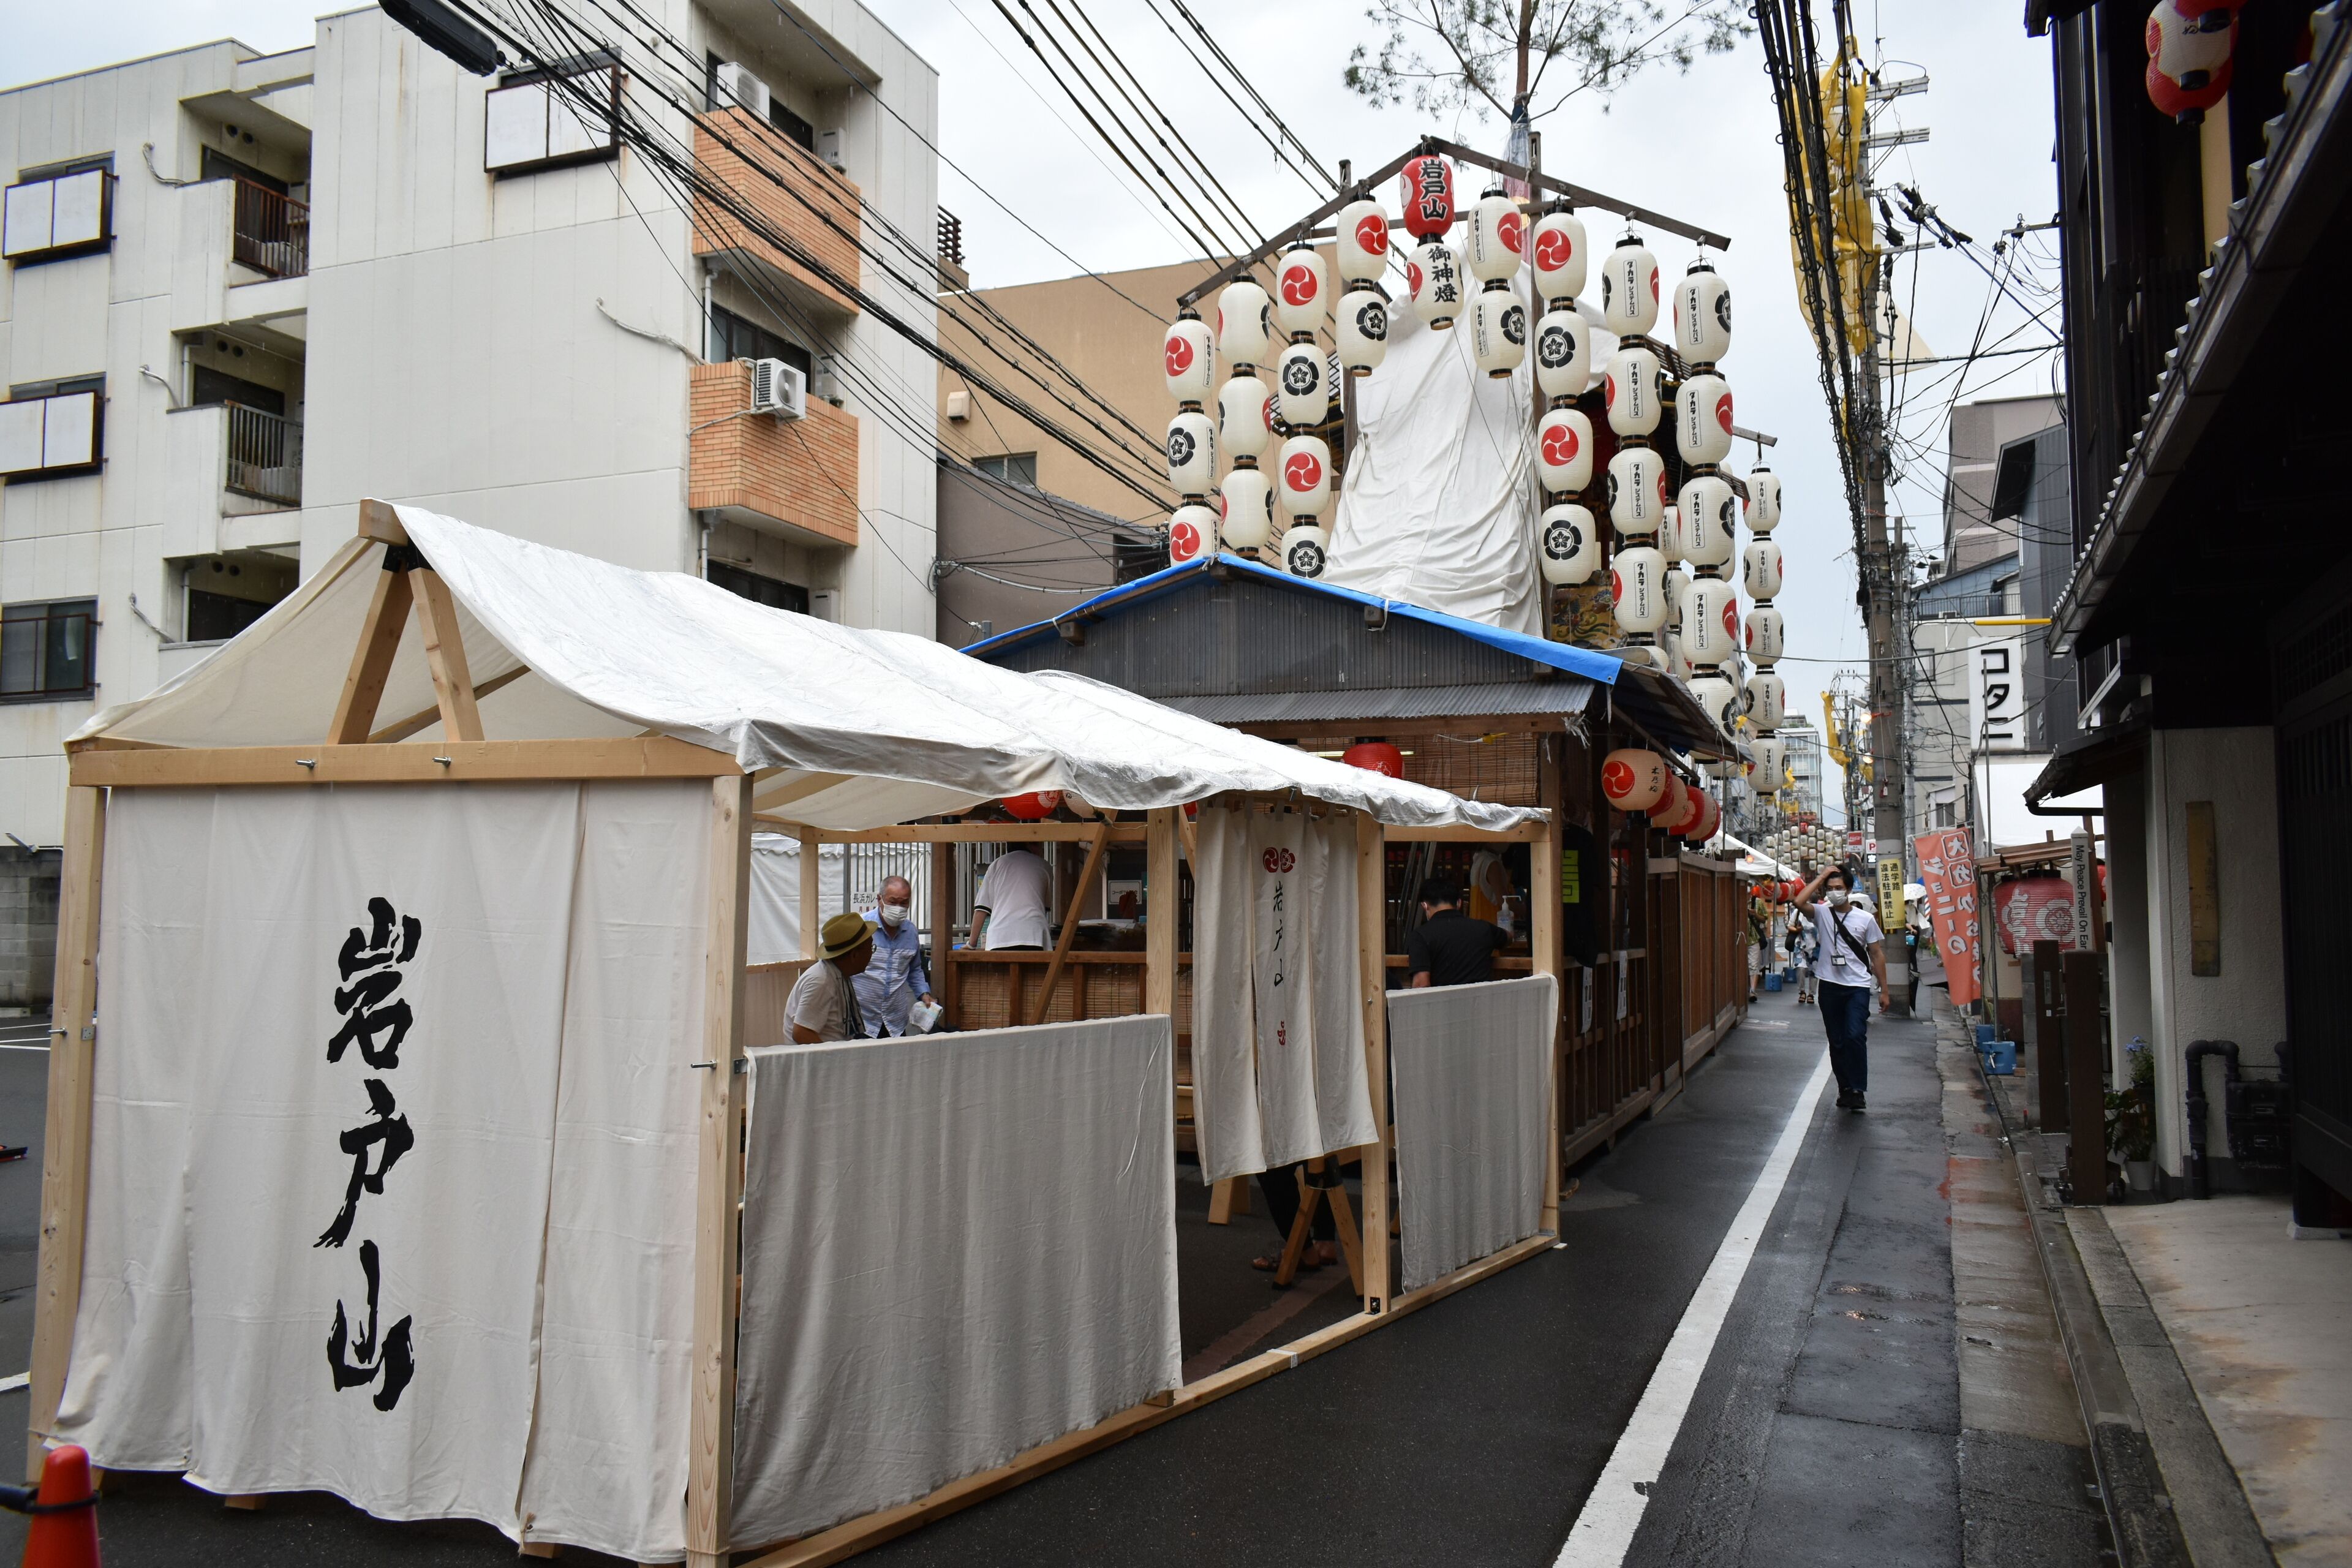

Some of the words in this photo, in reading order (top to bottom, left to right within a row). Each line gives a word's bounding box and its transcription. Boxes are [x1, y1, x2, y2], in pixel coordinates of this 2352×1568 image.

[1419, 158, 1448, 221] 岩戸山
[1427, 245, 1458, 303] 御神燈
[1980, 648, 2013, 739] コタニ
[1890, 863, 1900, 891] 通学路
[2076, 845, 2085, 862] May
[1881, 864, 1894, 919] 違法駐車禁止
[1922, 856, 1967, 955] ジョニーの
[2078, 892, 2087, 919] Prevail
[2079, 921, 2088, 932] On
[313, 896, 423, 1412] 岩戸山
